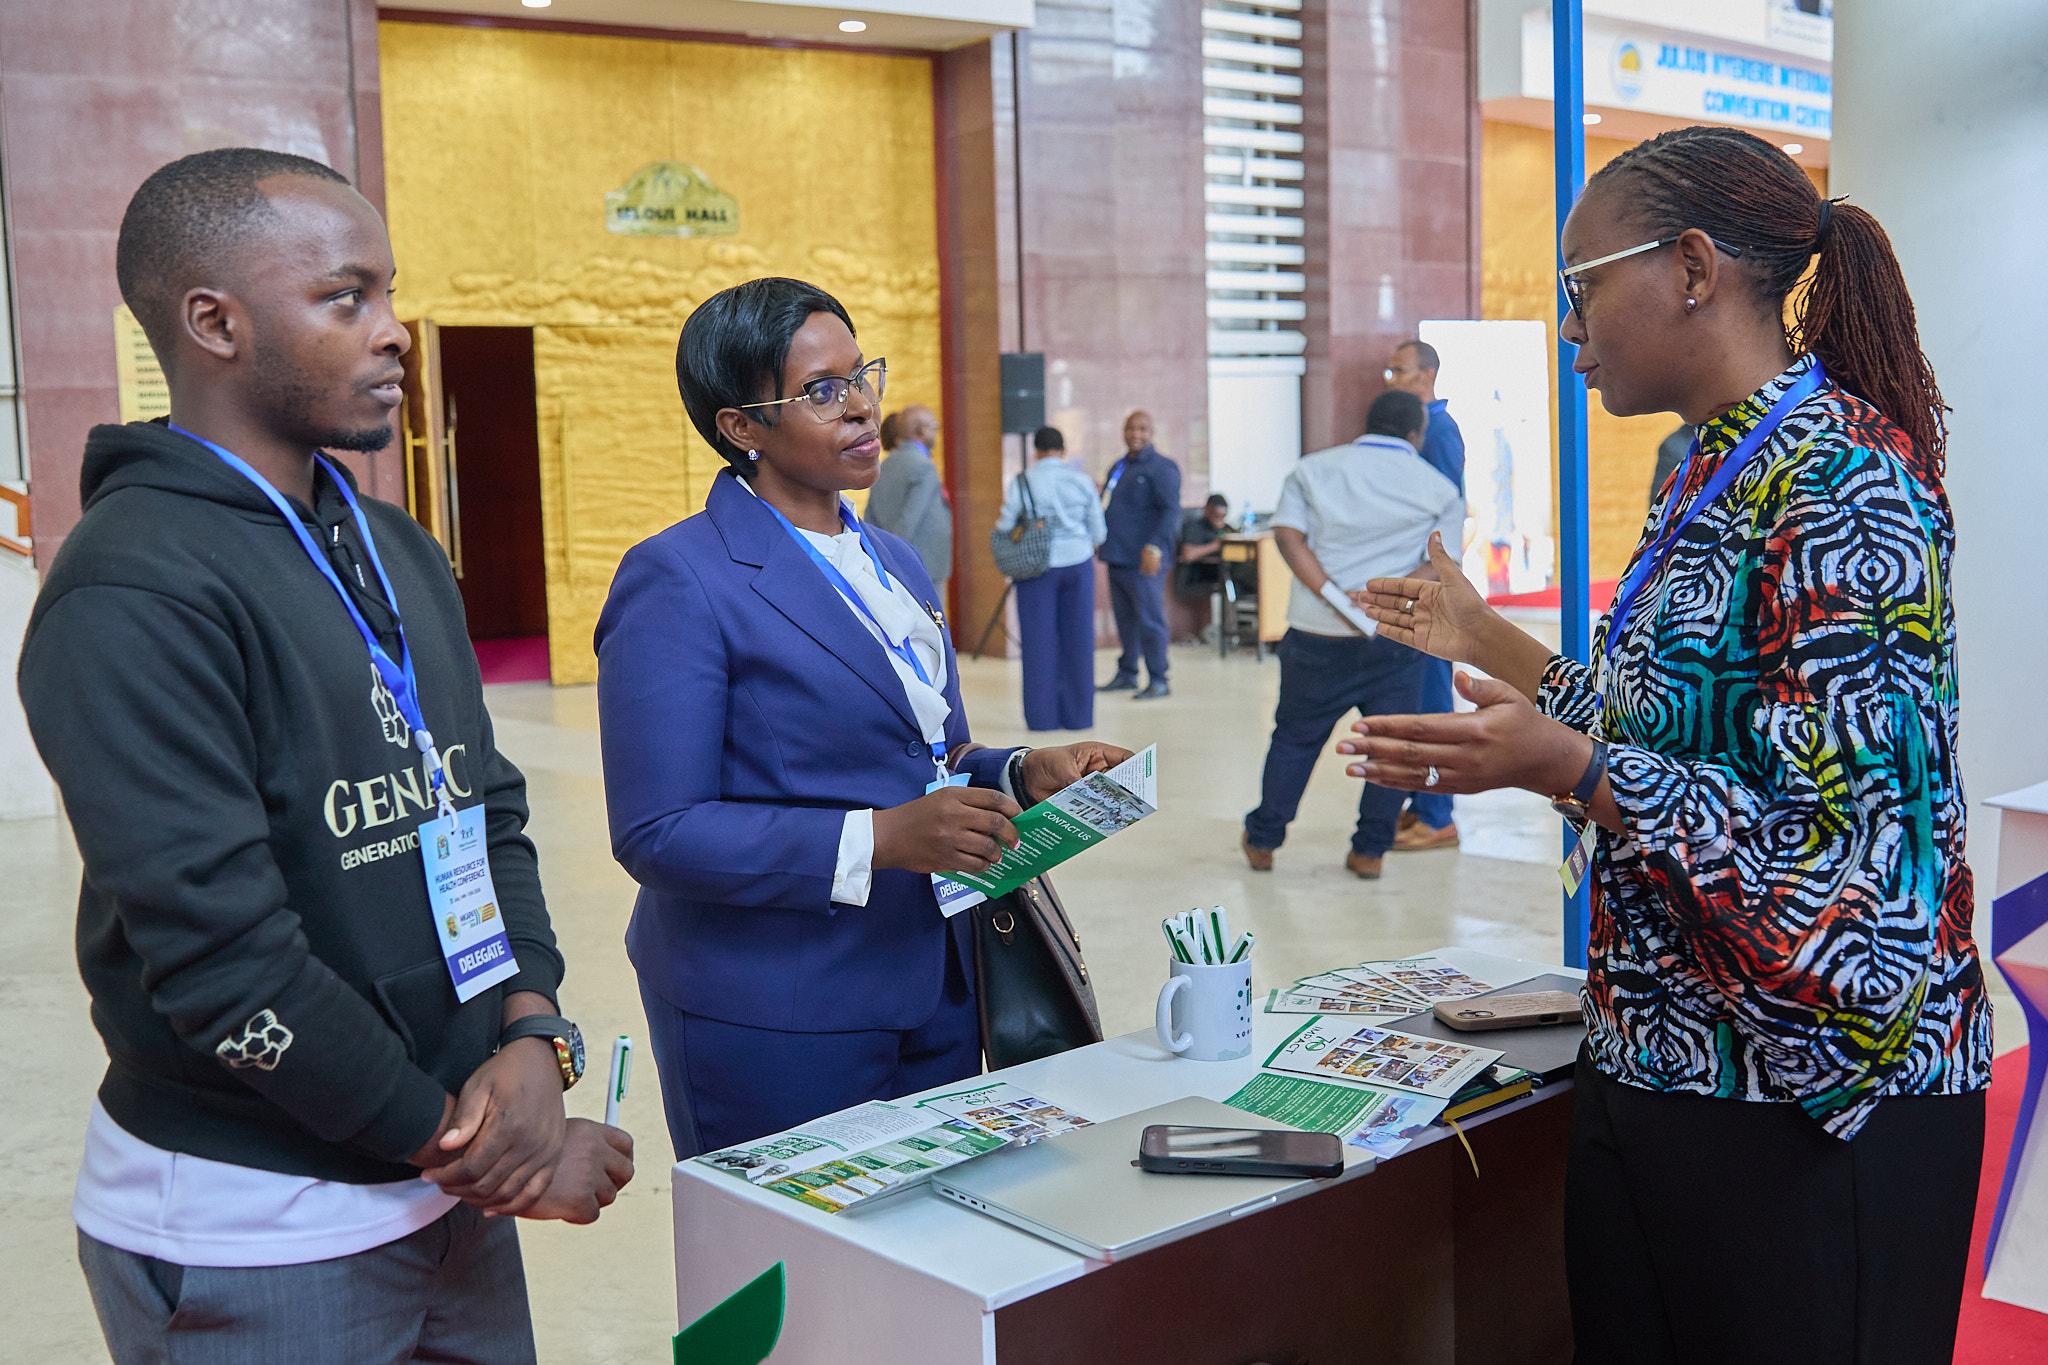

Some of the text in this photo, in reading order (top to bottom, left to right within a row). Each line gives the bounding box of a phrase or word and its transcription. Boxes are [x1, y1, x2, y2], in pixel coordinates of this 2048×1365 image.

[1704, 90, 1790, 122] CONVENTION
[685, 208, 728, 223] HALL
[1042, 811, 1078, 834] CONTACT
[1076, 829, 1092, 841] US
[435, 857, 486, 883] HUMAN RESOURCE FOR
[439, 868, 486, 894] HEALTH CONFERENCE
[458, 940, 506, 975] DELEGATE
[1285, 1026, 1324, 1055] IMPACT
[948, 1089, 997, 1102] IMPACT
